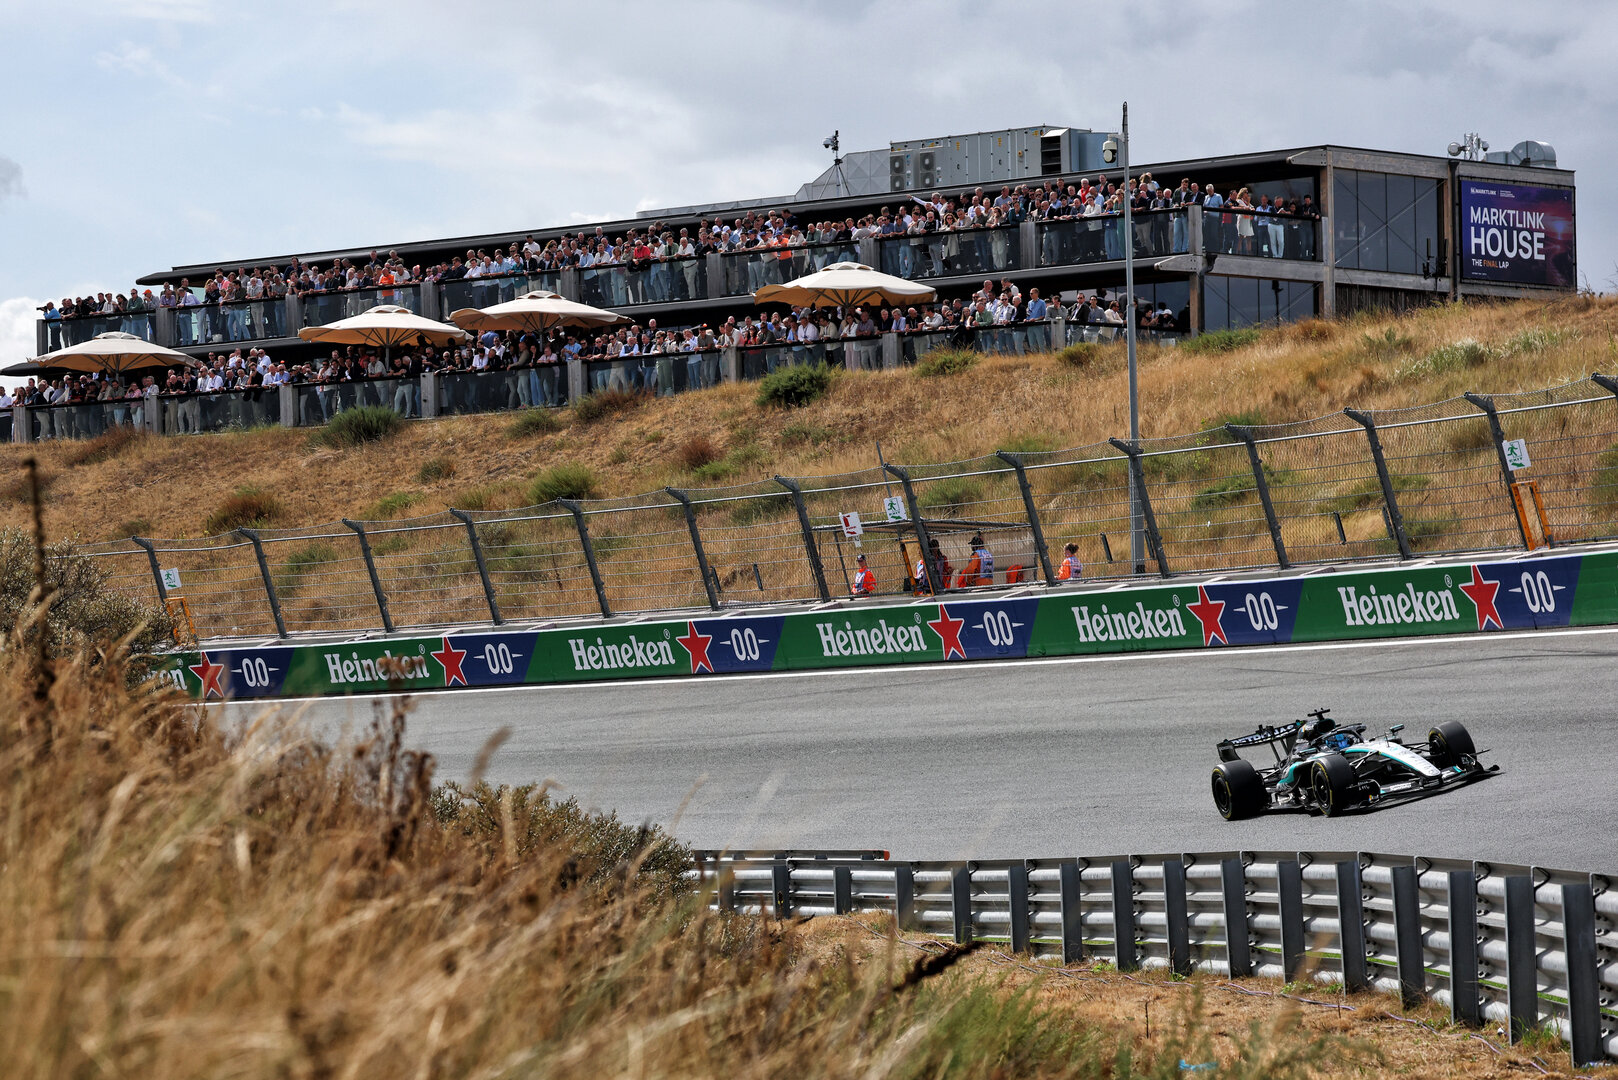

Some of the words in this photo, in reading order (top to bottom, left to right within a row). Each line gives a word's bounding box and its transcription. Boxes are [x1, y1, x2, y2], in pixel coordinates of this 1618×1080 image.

[1470, 206, 1545, 230] MARKTLINK
[1470, 226, 1546, 261] HOUSE
[1471, 258, 1483, 267] THE
[1483, 259, 1498, 268] FINAL
[1498, 260, 1510, 269] LAP
[1337, 582, 1460, 626] Heineken
[816, 619, 927, 657] Heineken
[1071, 602, 1187, 643] Heineken
[568, 635, 676, 671] Heineken
